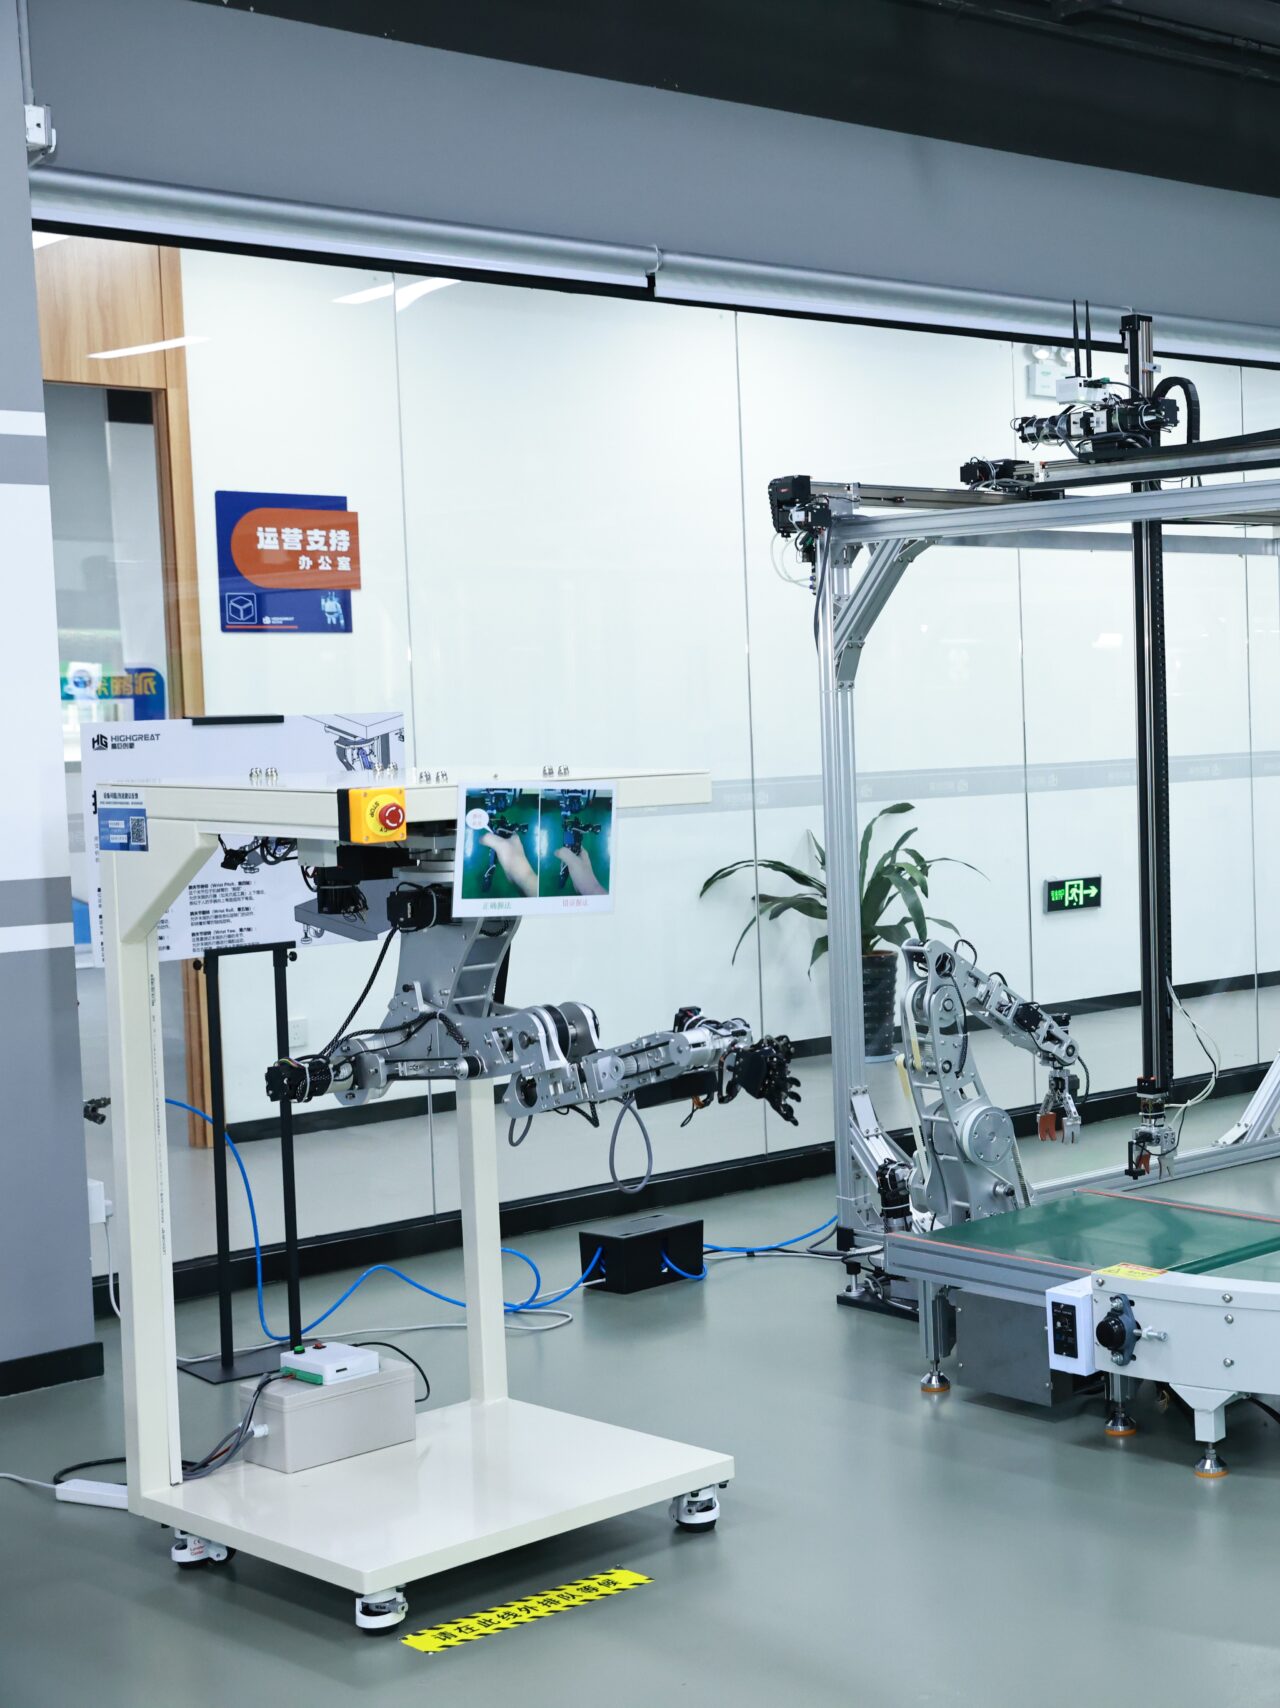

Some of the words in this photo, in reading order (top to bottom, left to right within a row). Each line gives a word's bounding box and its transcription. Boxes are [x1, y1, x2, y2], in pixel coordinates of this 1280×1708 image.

[256, 526, 350, 551] 运营支持
[298, 555, 351, 571] 办公室
[110, 733, 160, 742] HIGHGREAT
[369, 801, 380, 818] STOP
[434, 1577, 622, 1643] 请在此线外排队等候
